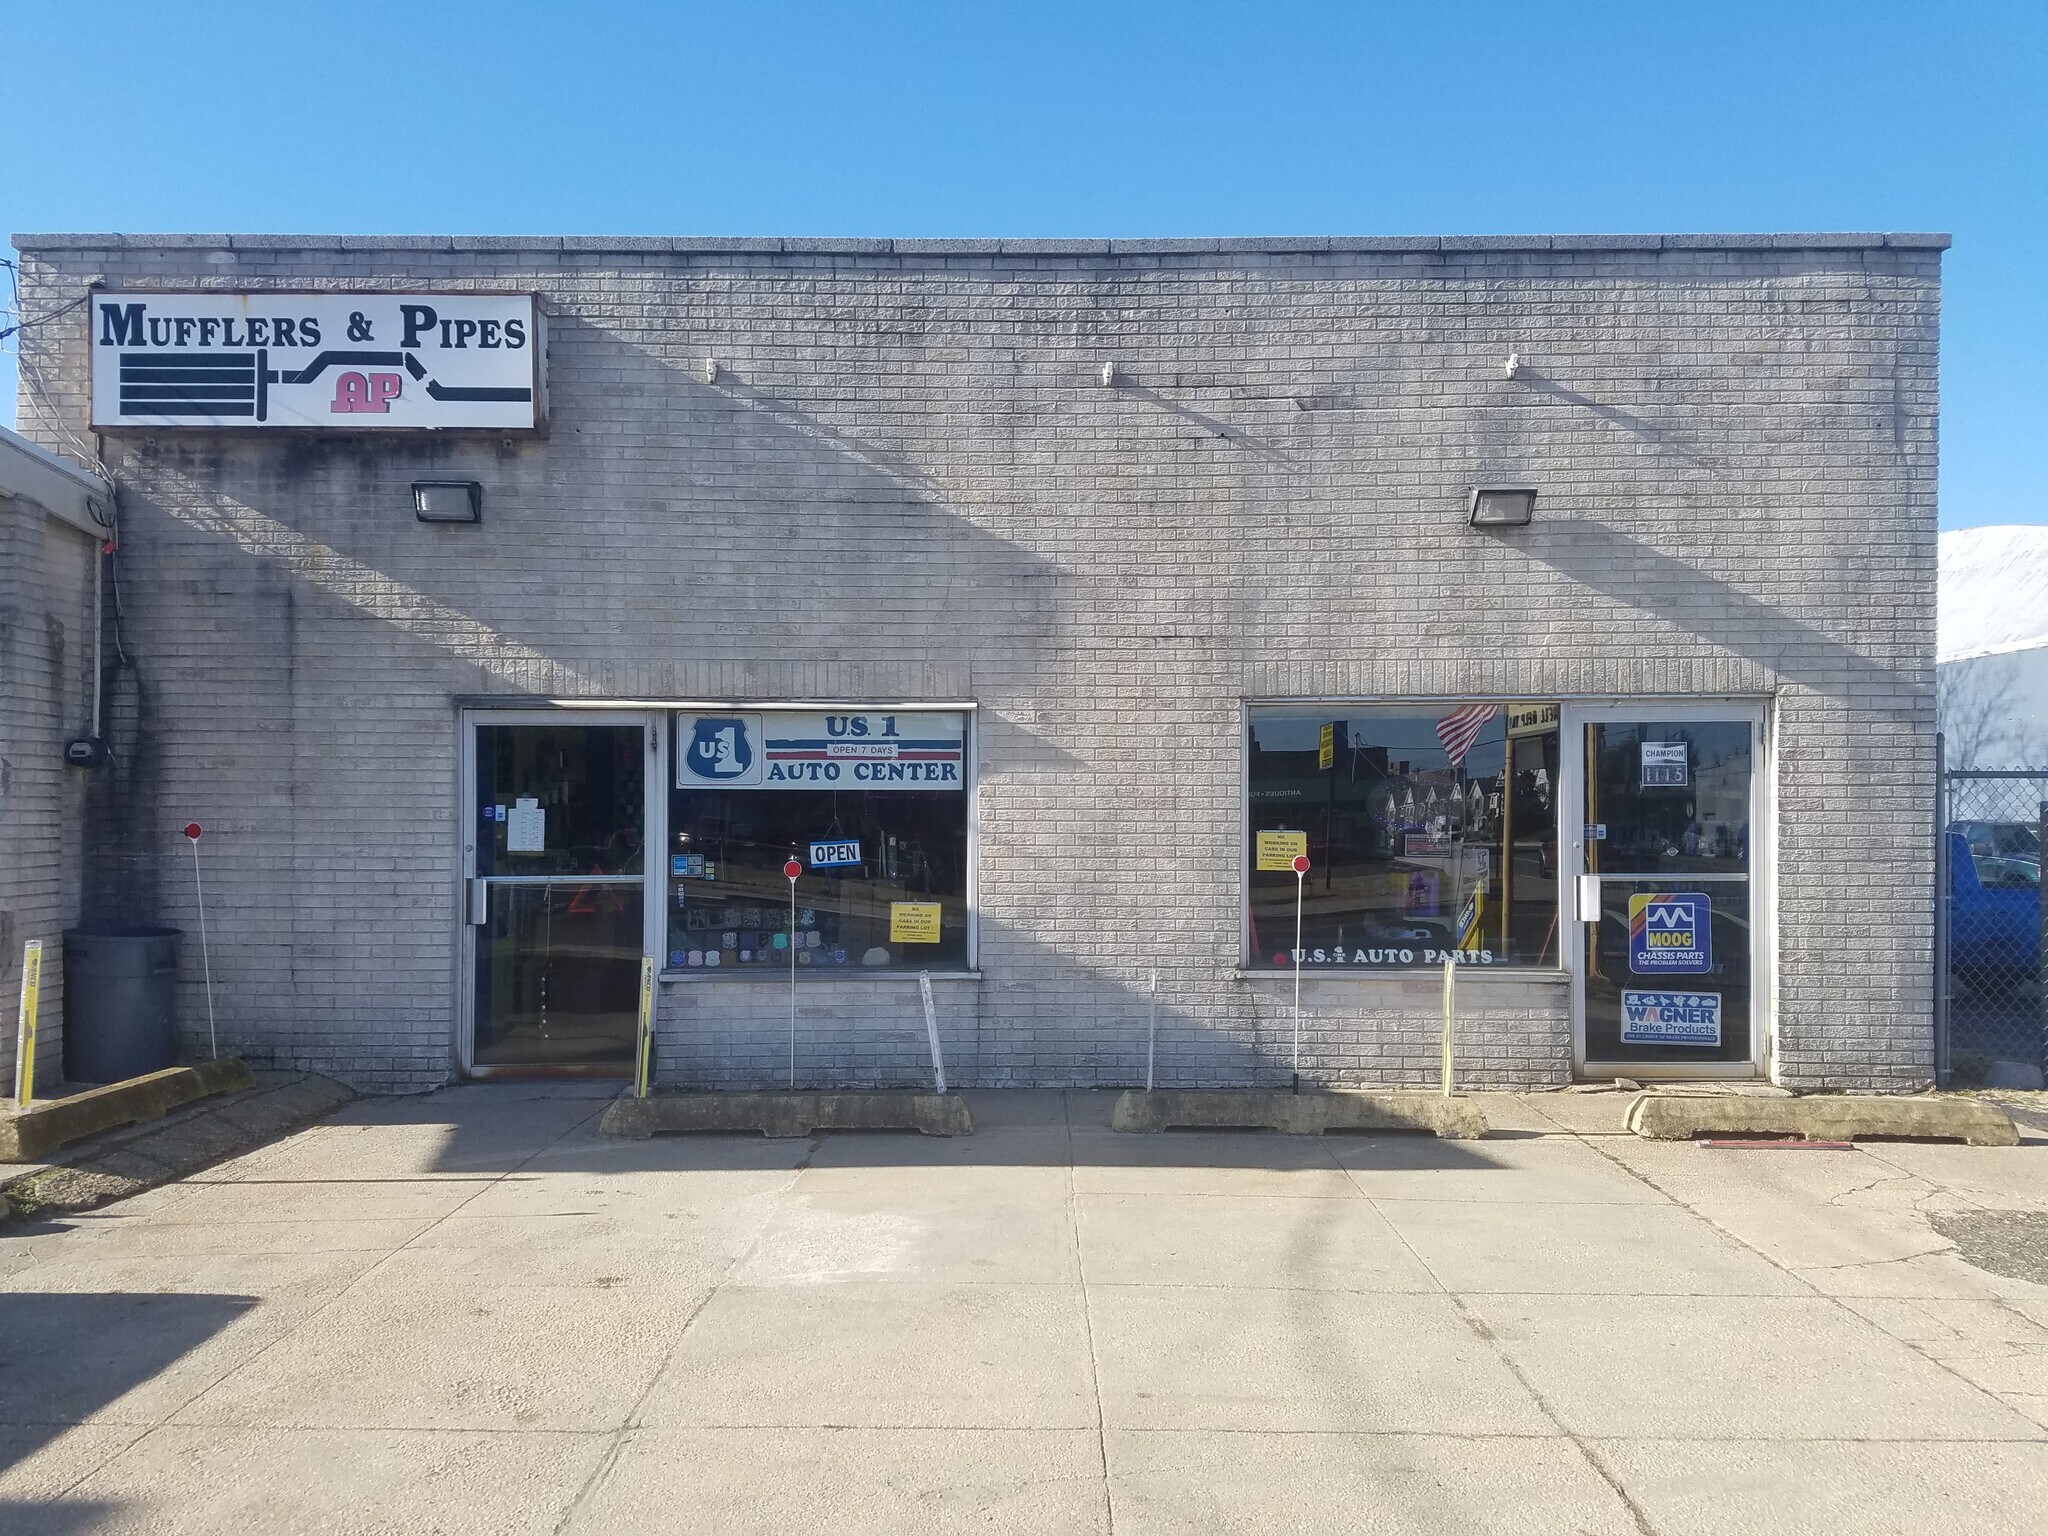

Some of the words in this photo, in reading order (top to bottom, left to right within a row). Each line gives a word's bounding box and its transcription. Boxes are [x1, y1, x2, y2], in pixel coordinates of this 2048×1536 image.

[99, 303, 321, 348] MUFFLERS
[347, 311, 375, 342] &
[400, 304, 526, 350] PIPES
[330, 372, 402, 413] AP
[881, 716, 900, 737] 1
[699, 741, 730, 759] US
[714, 727, 743, 772] 1
[833, 746, 858, 754] OPEN
[861, 747, 867, 755] 7
[870, 747, 893, 755] DAYS
[1645, 749, 1684, 758] CHAMPION
[767, 763, 841, 781] AUTO
[853, 763, 958, 781] CENTER
[815, 844, 857, 863] OPEN
[1649, 932, 1692, 947] MOOG
[1353, 949, 1414, 963] AUTO
[1424, 949, 1493, 964] PARTS
[1637, 951, 1675, 960] CHASSIS
[1676, 951, 1704, 960] PARTS
[1626, 1007, 1716, 1024] WAGNER
[1630, 1023, 1662, 1033] Brake
[1666, 1024, 1716, 1034] Products
